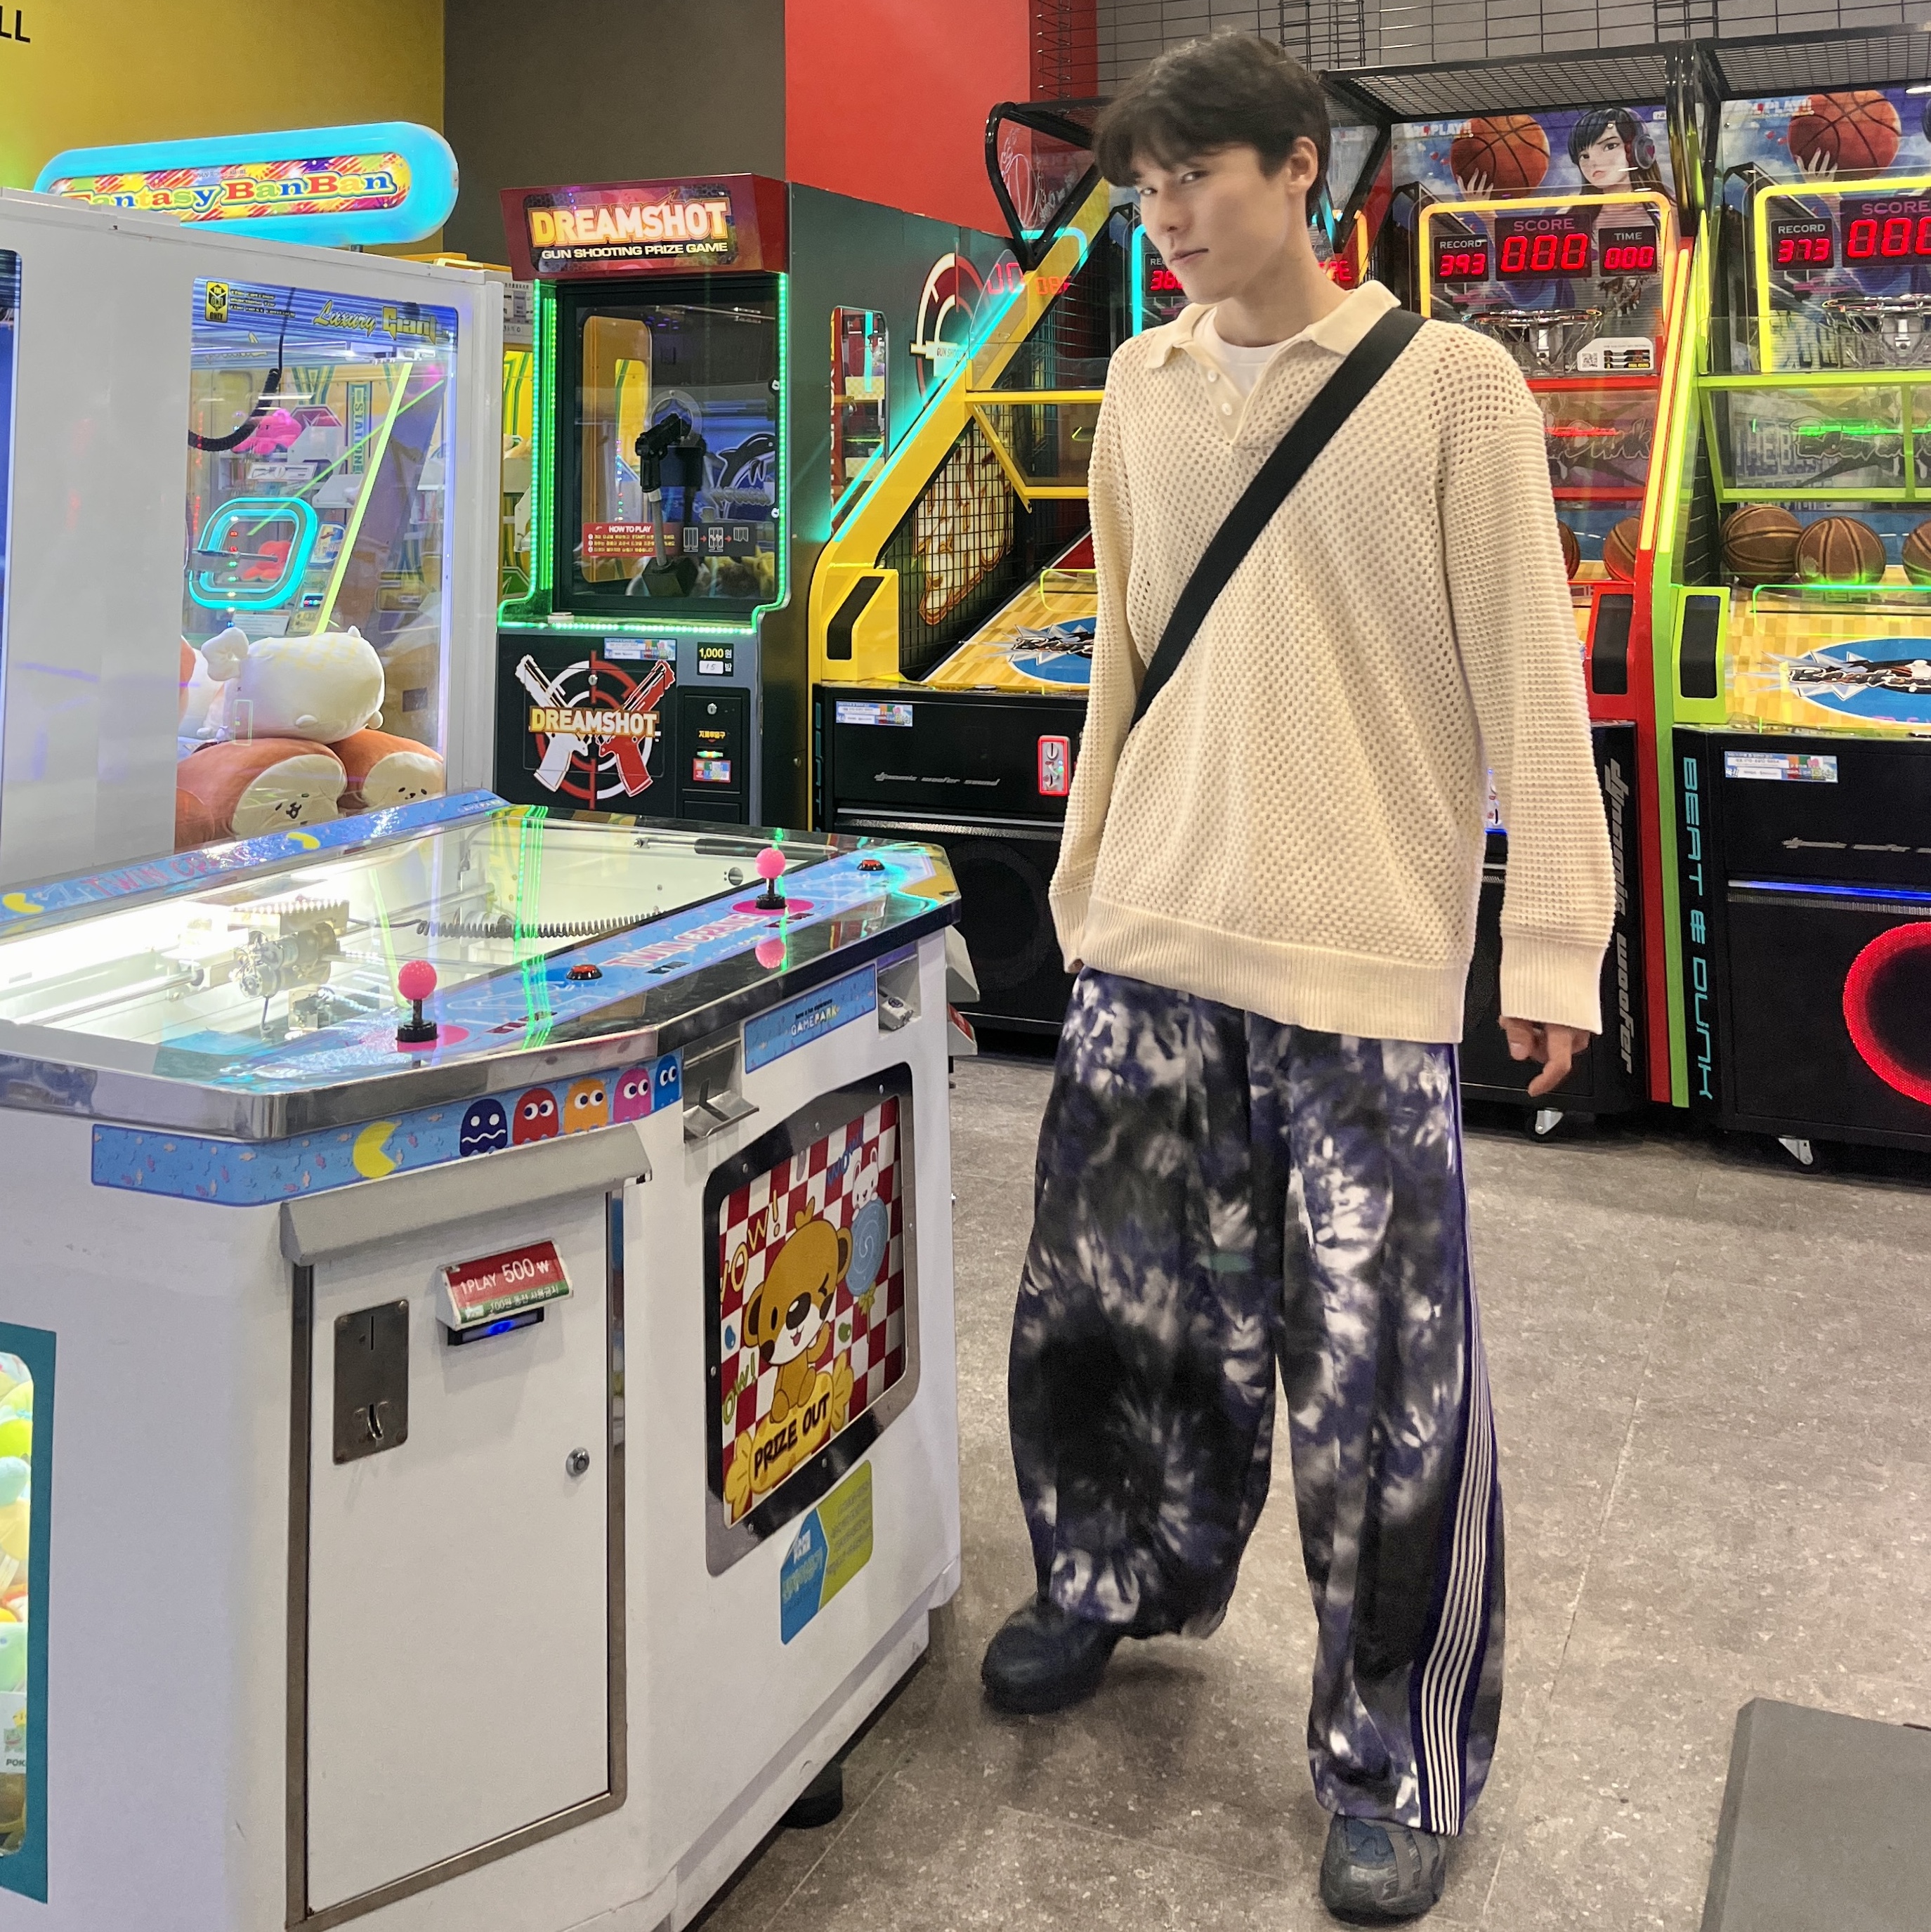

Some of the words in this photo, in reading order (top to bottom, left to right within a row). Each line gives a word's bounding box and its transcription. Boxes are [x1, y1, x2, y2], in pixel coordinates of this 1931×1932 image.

[1861, 200, 1930, 214] SCORE
[529, 197, 729, 246] DREAMSHOT
[1513, 218, 1575, 232] SCORE
[1778, 224, 1826, 234] RECORD
[1439, 240, 1483, 249] RECORD
[1614, 233, 1642, 241] TIME
[542, 249, 571, 260] GUN
[574, 245, 642, 259] SHOOTING
[645, 242, 683, 255] PRIZE
[686, 242, 728, 253] GAME
[1500, 233, 1589, 273] 000
[1604, 246, 1654, 270] 000
[1777, 238, 1830, 263] 373
[1439, 254, 1486, 277] 393
[313, 299, 377, 337] Luxury
[699, 648, 724, 659] 1,000
[530, 707, 659, 738] DREAMSHOT
[1683, 757, 1703, 896] BEAT
[1616, 932, 1635, 1074] woofer
[502, 1258, 535, 1284] 500
[754, 1418, 797, 1480] PRIZE
[803, 1392, 830, 1437] OUT
